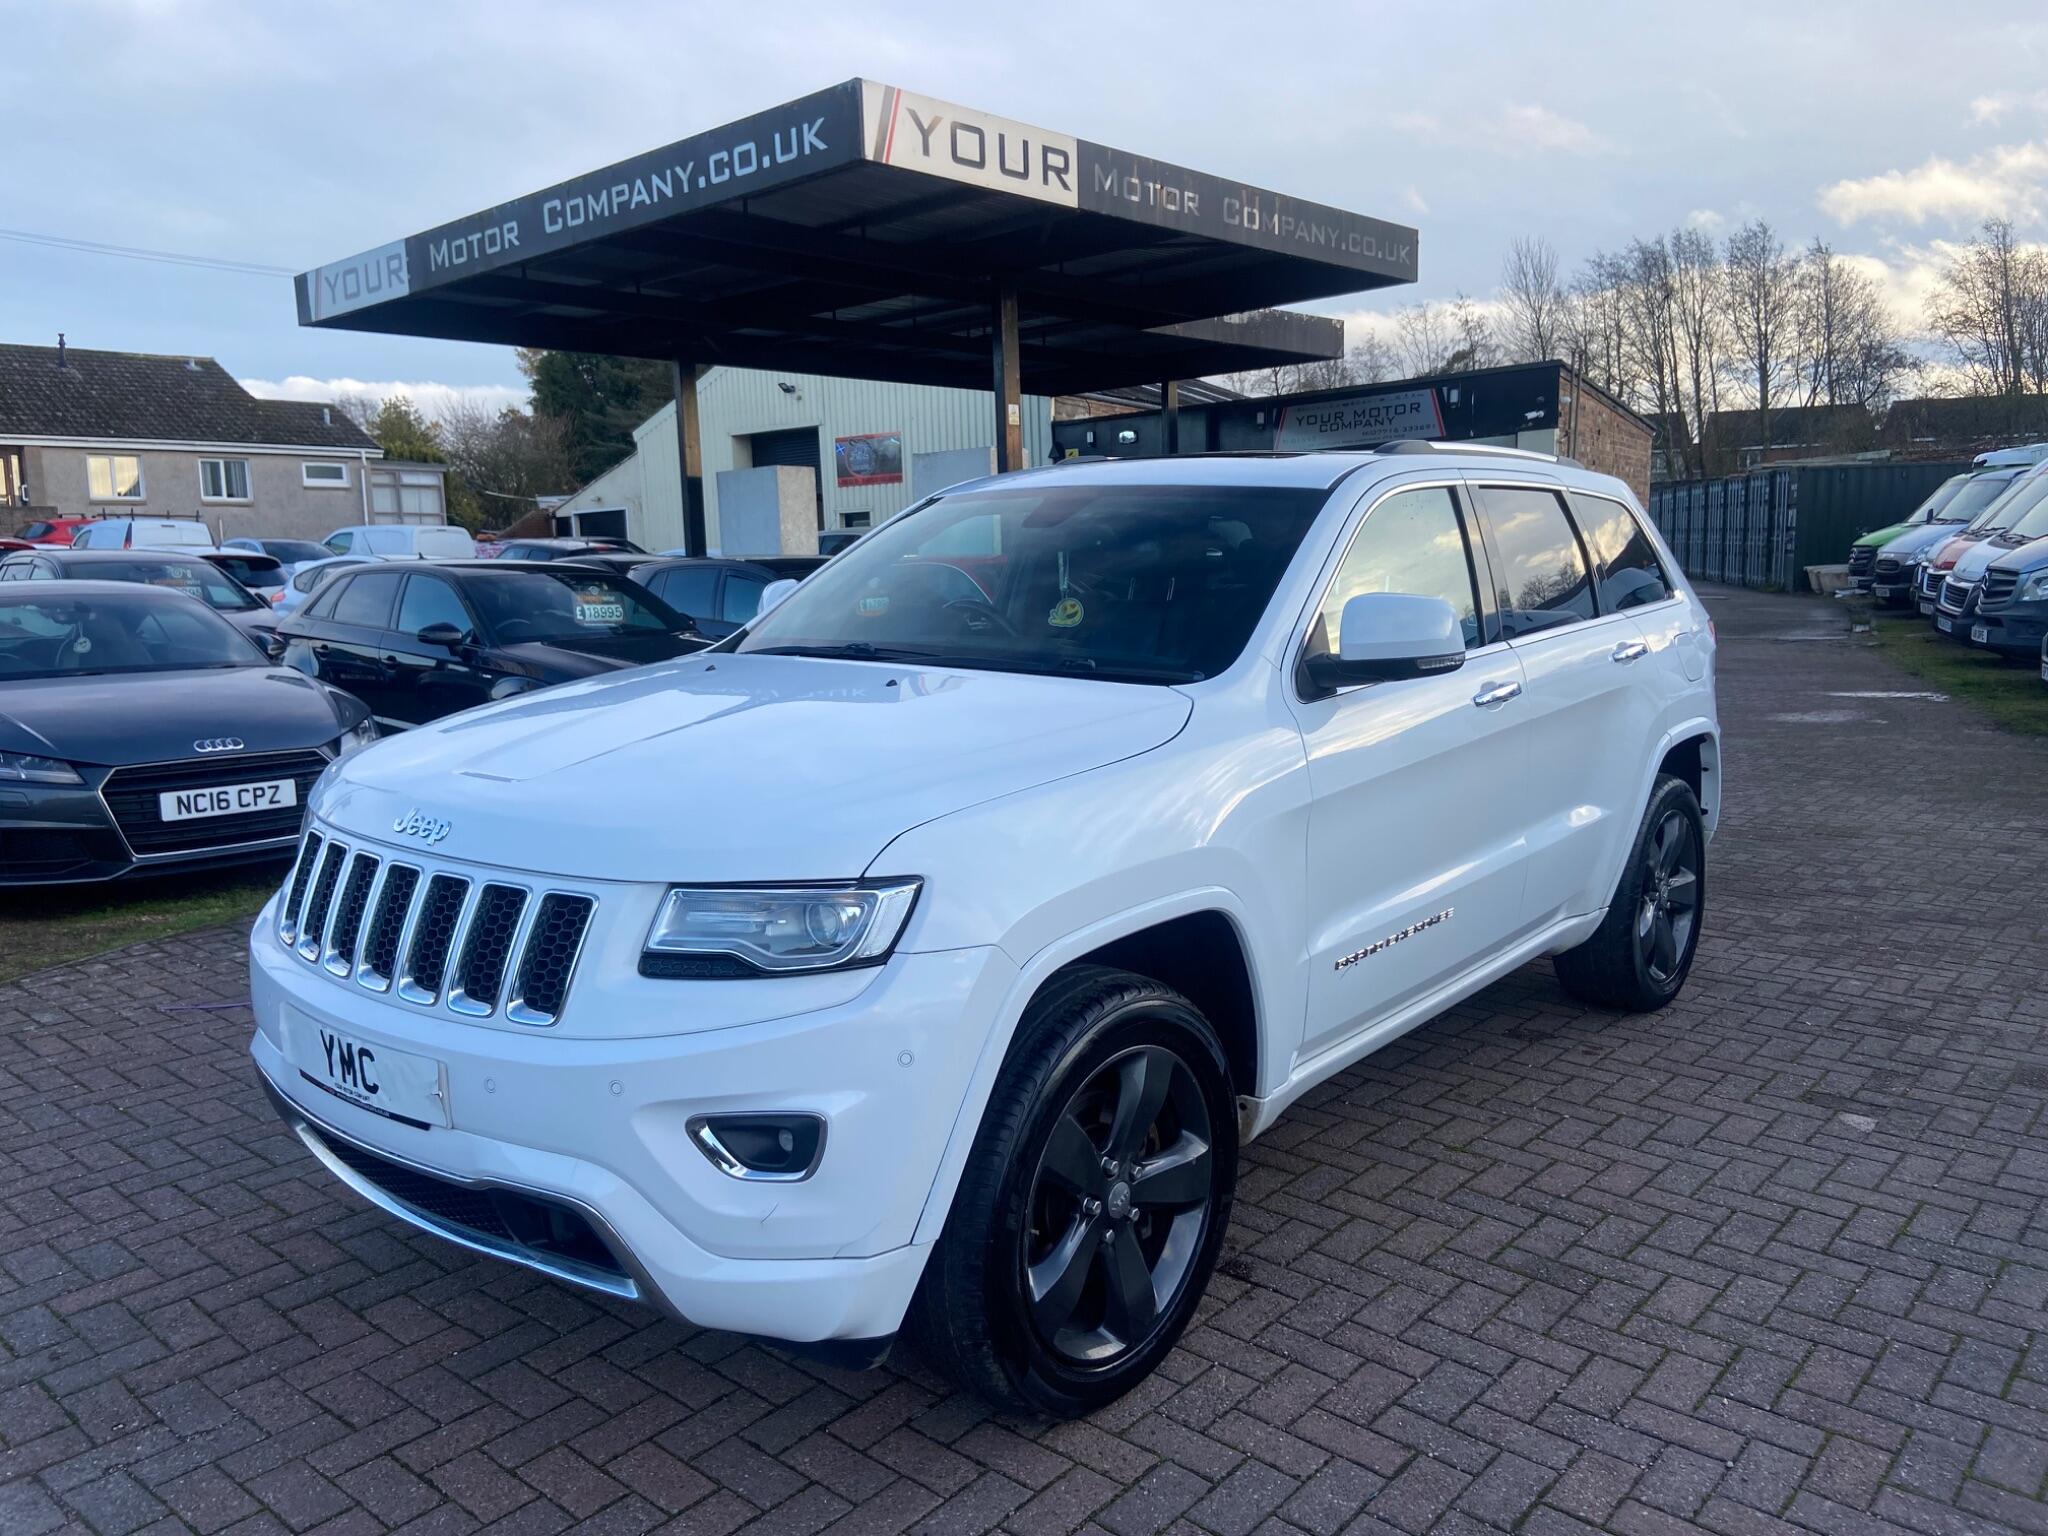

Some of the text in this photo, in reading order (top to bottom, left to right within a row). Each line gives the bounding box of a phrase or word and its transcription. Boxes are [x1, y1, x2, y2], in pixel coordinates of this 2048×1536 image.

[905, 106, 1073, 192] YOUR
[1093, 162, 1201, 217] MOTOR
[323, 116, 829, 305] YOUR MOTOR COMPANY.CO.UK
[1296, 411, 1345, 427] YOUR
[1353, 402, 1422, 420] MOTOR
[1319, 416, 1396, 433] COMPANY
[176, 785, 282, 816] NC16 CPZ
[393, 808, 452, 846] Jeep
[320, 1029, 380, 1095] YMC
